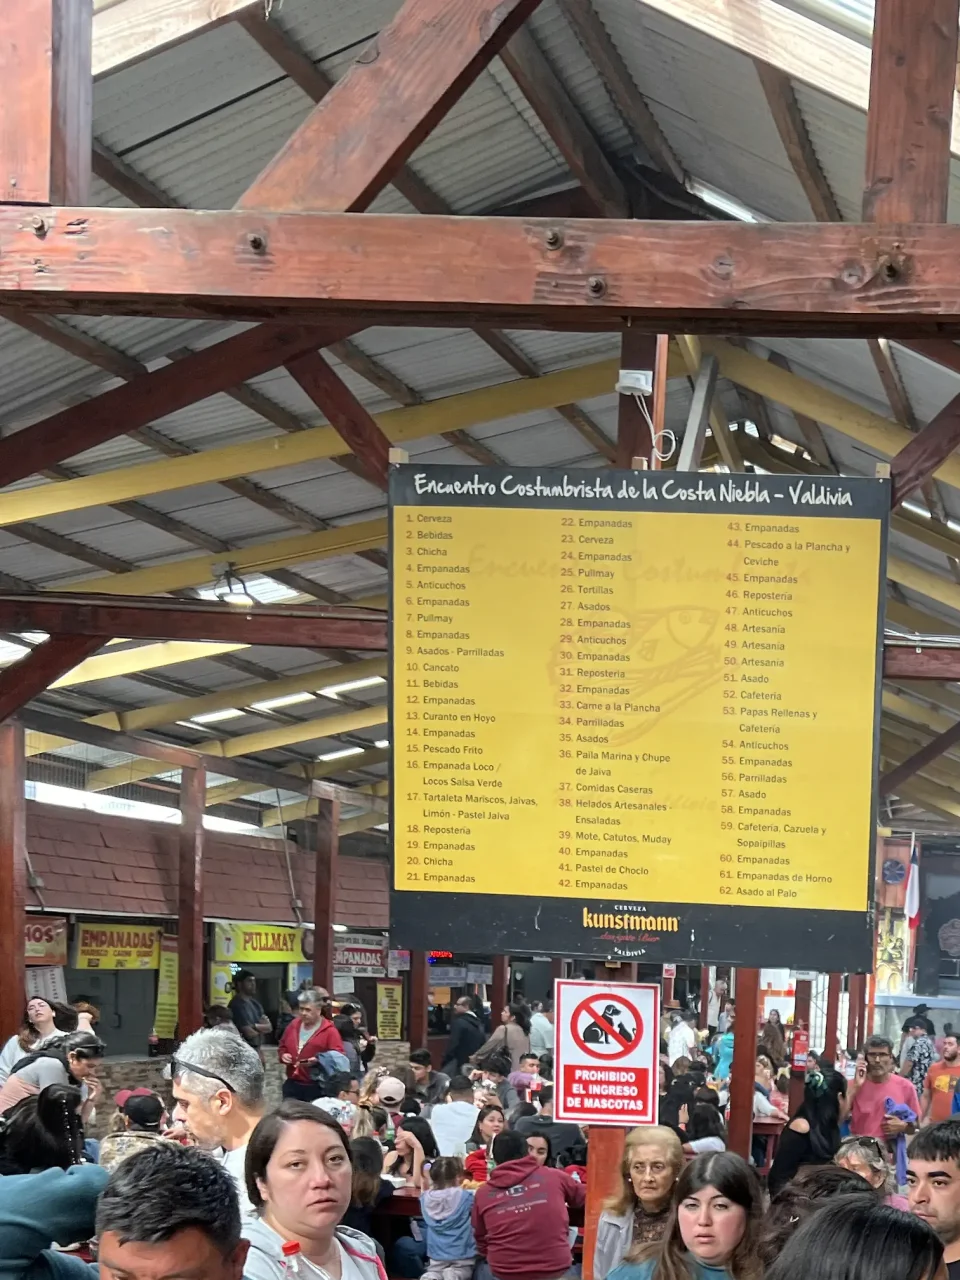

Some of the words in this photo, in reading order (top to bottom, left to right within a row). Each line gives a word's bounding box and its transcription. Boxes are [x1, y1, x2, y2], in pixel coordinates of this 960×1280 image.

[413, 473, 496, 495] Encuentro
[500, 474, 614, 499] Costumbrista
[617, 479, 638, 499] de
[642, 478, 658, 500] la
[661, 478, 717, 502] Costa
[720, 479, 770, 503] Niebla
[788, 480, 853, 506] Valdivia
[416, 513, 452, 523] Cerveza
[579, 518, 633, 528] Empanadas
[745, 522, 800, 533] Empanadas
[417, 530, 453, 540] Bebidas
[578, 535, 614, 545] Cerveza
[416, 547, 448, 556] Chicha
[744, 539, 784, 550] Pescado
[794, 541, 803, 550] la
[805, 542, 843, 552] Plancha
[845, 545, 850, 553] y
[578, 551, 633, 562] Empanadas
[743, 556, 779, 567] Ceviche
[417, 563, 471, 574] Empanadas
[578, 568, 615, 580] Pullmay
[743, 573, 798, 584] Empanadas
[416, 580, 466, 590] Anticuchos
[577, 585, 614, 595] Tortillas
[417, 596, 470, 607] Empanadas
[577, 601, 611, 611] Asados
[742, 607, 793, 618] Anticuchos
[417, 613, 453, 625] Pullmay
[577, 618, 631, 629] Empanadas
[417, 629, 470, 640] Empanadas
[577, 635, 627, 645] Anticuchos
[417, 646, 450, 656] Asados
[456, 647, 505, 657] Parrilladas
[577, 651, 631, 662] Empanadas
[422, 662, 460, 673] Cancato
[423, 679, 459, 689] Bebidas
[740, 674, 769, 684] Asado
[576, 684, 630, 695] Empanadas
[423, 695, 476, 706] Empanadas
[576, 701, 603, 710] Carne
[605, 703, 611, 711] a
[613, 702, 622, 711] la
[624, 702, 661, 713] Plancha
[422, 711, 458, 721] Curanto
[460, 714, 472, 722] en
[473, 713, 496, 724] Hoyo
[740, 707, 769, 718] Papas
[771, 708, 811, 718] Rellenas
[812, 711, 818, 720] y
[576, 717, 625, 728] Parrilladas
[423, 728, 476, 739] Empanadas
[576, 733, 609, 744] Asados
[423, 744, 461, 754] Pescado
[463, 745, 484, 755] Frito
[739, 740, 789, 751] Anticuchos
[576, 750, 599, 760] Paila
[601, 751, 633, 761] Marina
[634, 754, 640, 763] y
[641, 752, 671, 764] Chupe
[739, 756, 793, 768] Empanadas
[423, 760, 471, 771] Empanada
[473, 762, 495, 772] Loco
[575, 767, 587, 776] de
[588, 767, 612, 777] Jaiva
[423, 776, 449, 786] Locos
[450, 777, 475, 787] Salsa
[476, 778, 503, 788] Verde
[738, 773, 788, 784] Parrilladas
[576, 782, 615, 793] Comidas
[617, 784, 653, 795] Caseras
[738, 789, 767, 799] Asado
[423, 792, 463, 803] Tartaleta
[465, 794, 507, 805] Mariscos,
[508, 796, 538, 807] Jaivas,
[576, 799, 612, 809] Helados
[614, 800, 667, 811] Artesanales
[423, 809, 451, 818] Limón
[457, 810, 486, 820] Pastel
[487, 811, 510, 821] Jaiva
[738, 805, 792, 817] Empanadas
[575, 815, 621, 826] Ensaladas
[783, 824, 819, 834] Cazuela
[821, 828, 827, 836] y
[575, 831, 601, 842] Mote,
[602, 832, 640, 843] Catutos,
[642, 834, 672, 846] Muday
[737, 838, 786, 849] Sopaipillas
[423, 840, 476, 851] Empanadas
[575, 847, 629, 859] Empanadas
[423, 856, 453, 866] Chicha
[737, 854, 790, 866] Empanadas
[575, 863, 603, 873] Pastel
[605, 865, 617, 874] de
[618, 865, 649, 875] Choclo
[423, 872, 476, 883] Empanadas
[736, 870, 790, 882] Empanadas
[791, 874, 803, 882] de
[805, 874, 833, 883] Horno
[575, 879, 628, 891] Empanadas
[736, 886, 764, 897] Asado
[766, 888, 775, 897] al
[777, 888, 798, 898] Palo
[614, 904, 647, 912] CERVEZA
[582, 907, 679, 932] kunstmann
[81, 929, 155, 949] EMPANADAS
[242, 931, 296, 952] PULLMAY
[614, 946, 646, 957] VALDIVIA
[574, 1069, 636, 1083] PROHIBIDO
[572, 1083, 586, 1094] EL
[588, 1084, 638, 1096] INGRESO
[566, 1096, 581, 1108] DE
[583, 1097, 644, 1111] MASCOTAS
